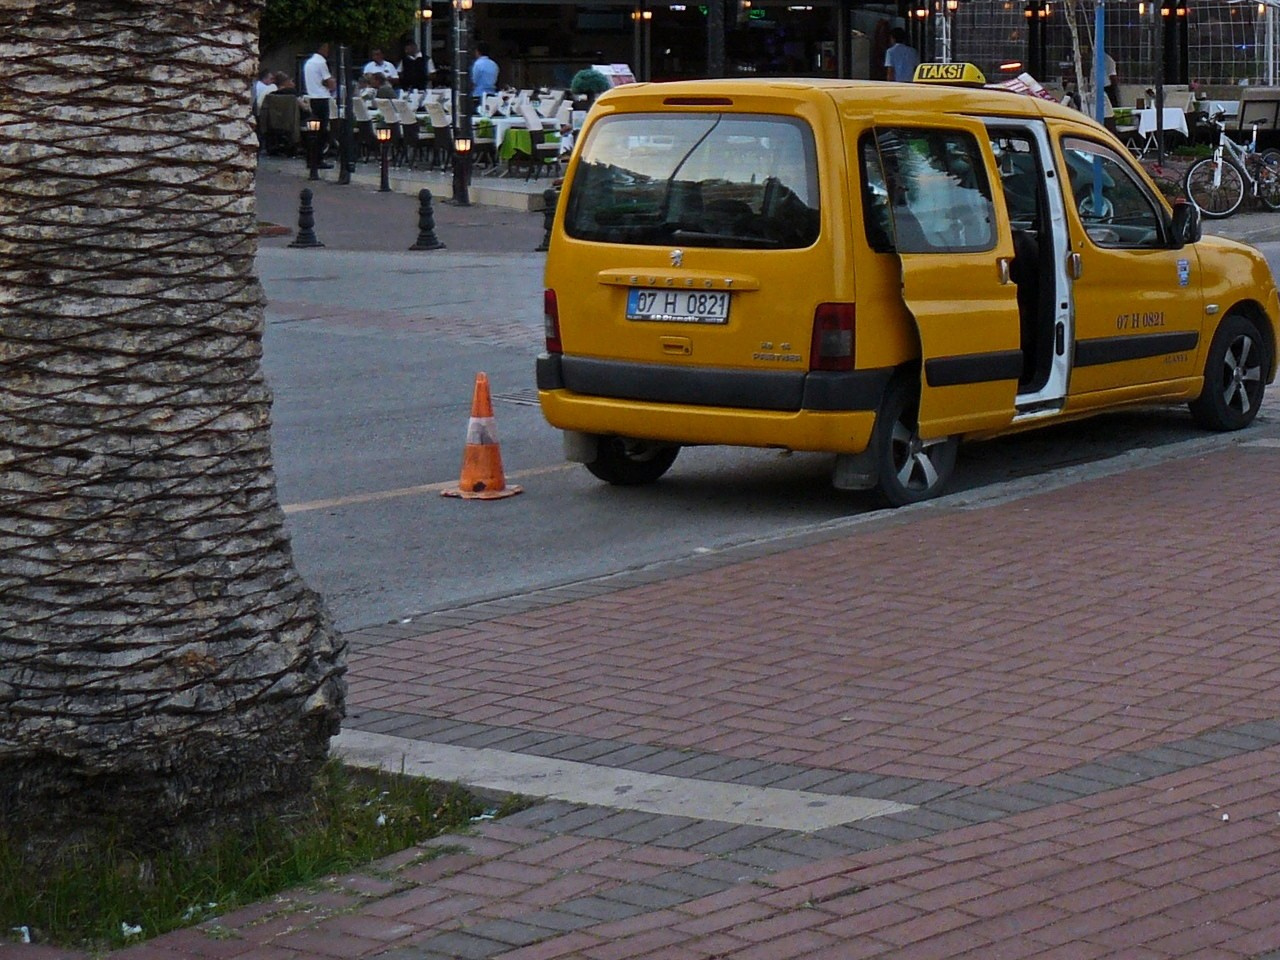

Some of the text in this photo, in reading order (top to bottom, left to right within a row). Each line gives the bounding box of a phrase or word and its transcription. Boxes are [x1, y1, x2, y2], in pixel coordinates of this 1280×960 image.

[615, 275, 733, 288] PEUGEOT
[637, 292, 726, 315] 07 H 0821
[1116, 311, 1165, 329] 07 H 0821
